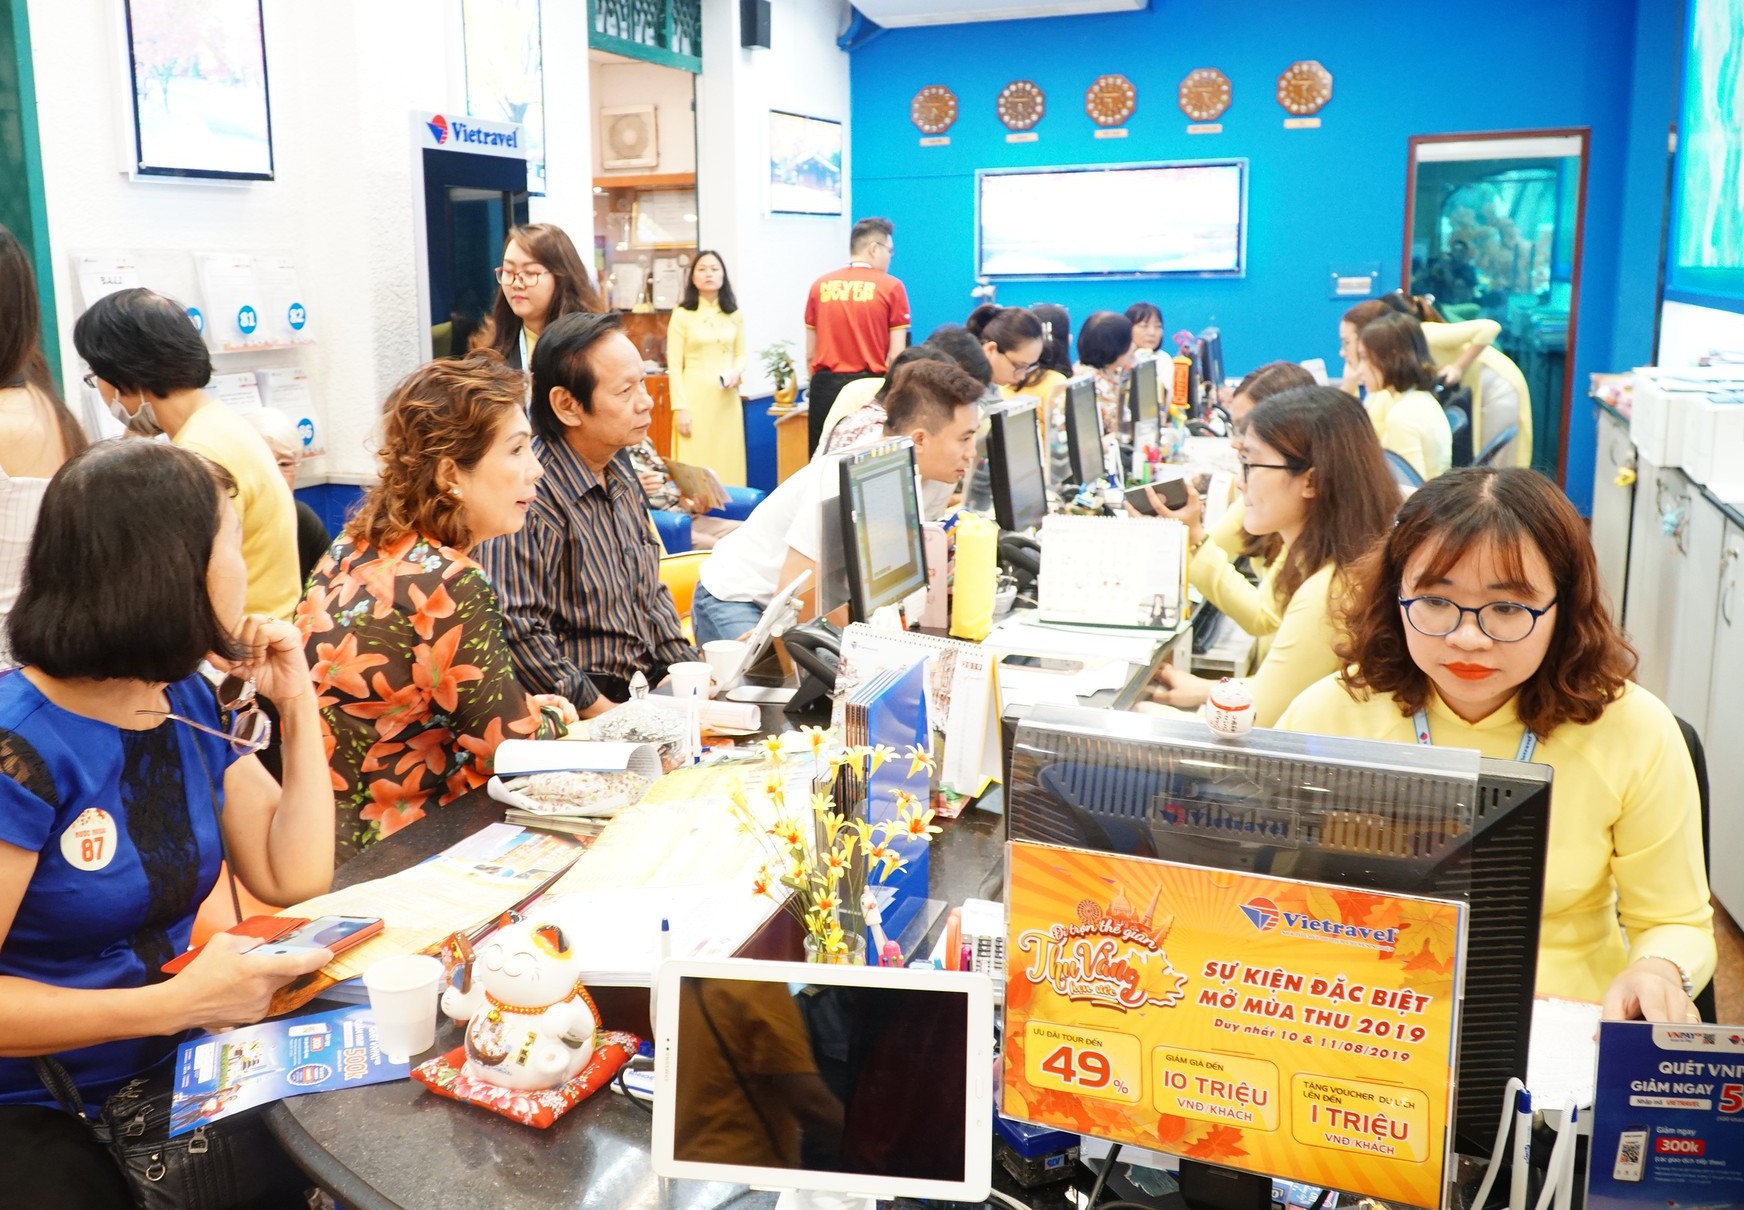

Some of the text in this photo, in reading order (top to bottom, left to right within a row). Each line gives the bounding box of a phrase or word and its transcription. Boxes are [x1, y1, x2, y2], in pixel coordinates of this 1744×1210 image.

[451, 121, 518, 148] Vietravel
[239, 311, 256, 328] 81
[289, 308, 305, 324] 82
[1190, 808, 1289, 839] Vietravel
[81, 836, 104, 862] 87
[1070, 923, 1096, 937] trọn
[1099, 917, 1122, 933] thế
[1123, 928, 1157, 949] gian
[1283, 912, 1397, 943] Vietravel
[1021, 931, 1146, 1004] Thu Vàng
[1204, 961, 1431, 1016] SỰ KIỆN ĐẶC BIỆT
[1198, 988, 1426, 1043] MỞ MÙA THU 2019
[1062, 1034, 1084, 1044] TOUR
[1214, 1018, 1411, 1062] Duy nhất 10 & 11/08/2019
[344, 1048, 368, 1081] 500k
[1041, 1046, 1129, 1094] 49 %
[1206, 1061, 1224, 1072] ĐẾN
[1658, 1060, 1705, 1076] QUÉT
[1164, 1070, 1268, 1107] 10 TRIỆU
[1303, 1091, 1342, 1105] LÊN ĐẾN
[1330, 1086, 1375, 1101] VOUCHER
[1630, 1078, 1671, 1093] GIẢM
[1672, 1082, 1715, 1095] NGAY
[1177, 1097, 1253, 1122] VNĐ/KHÁCH
[1325, 1107, 1409, 1141] TRIỆU
[1676, 1128, 1697, 1137] ngay
[1324, 1133, 1396, 1155] VNĐ/KHÁCH
[1661, 1139, 1699, 1153] 300k
